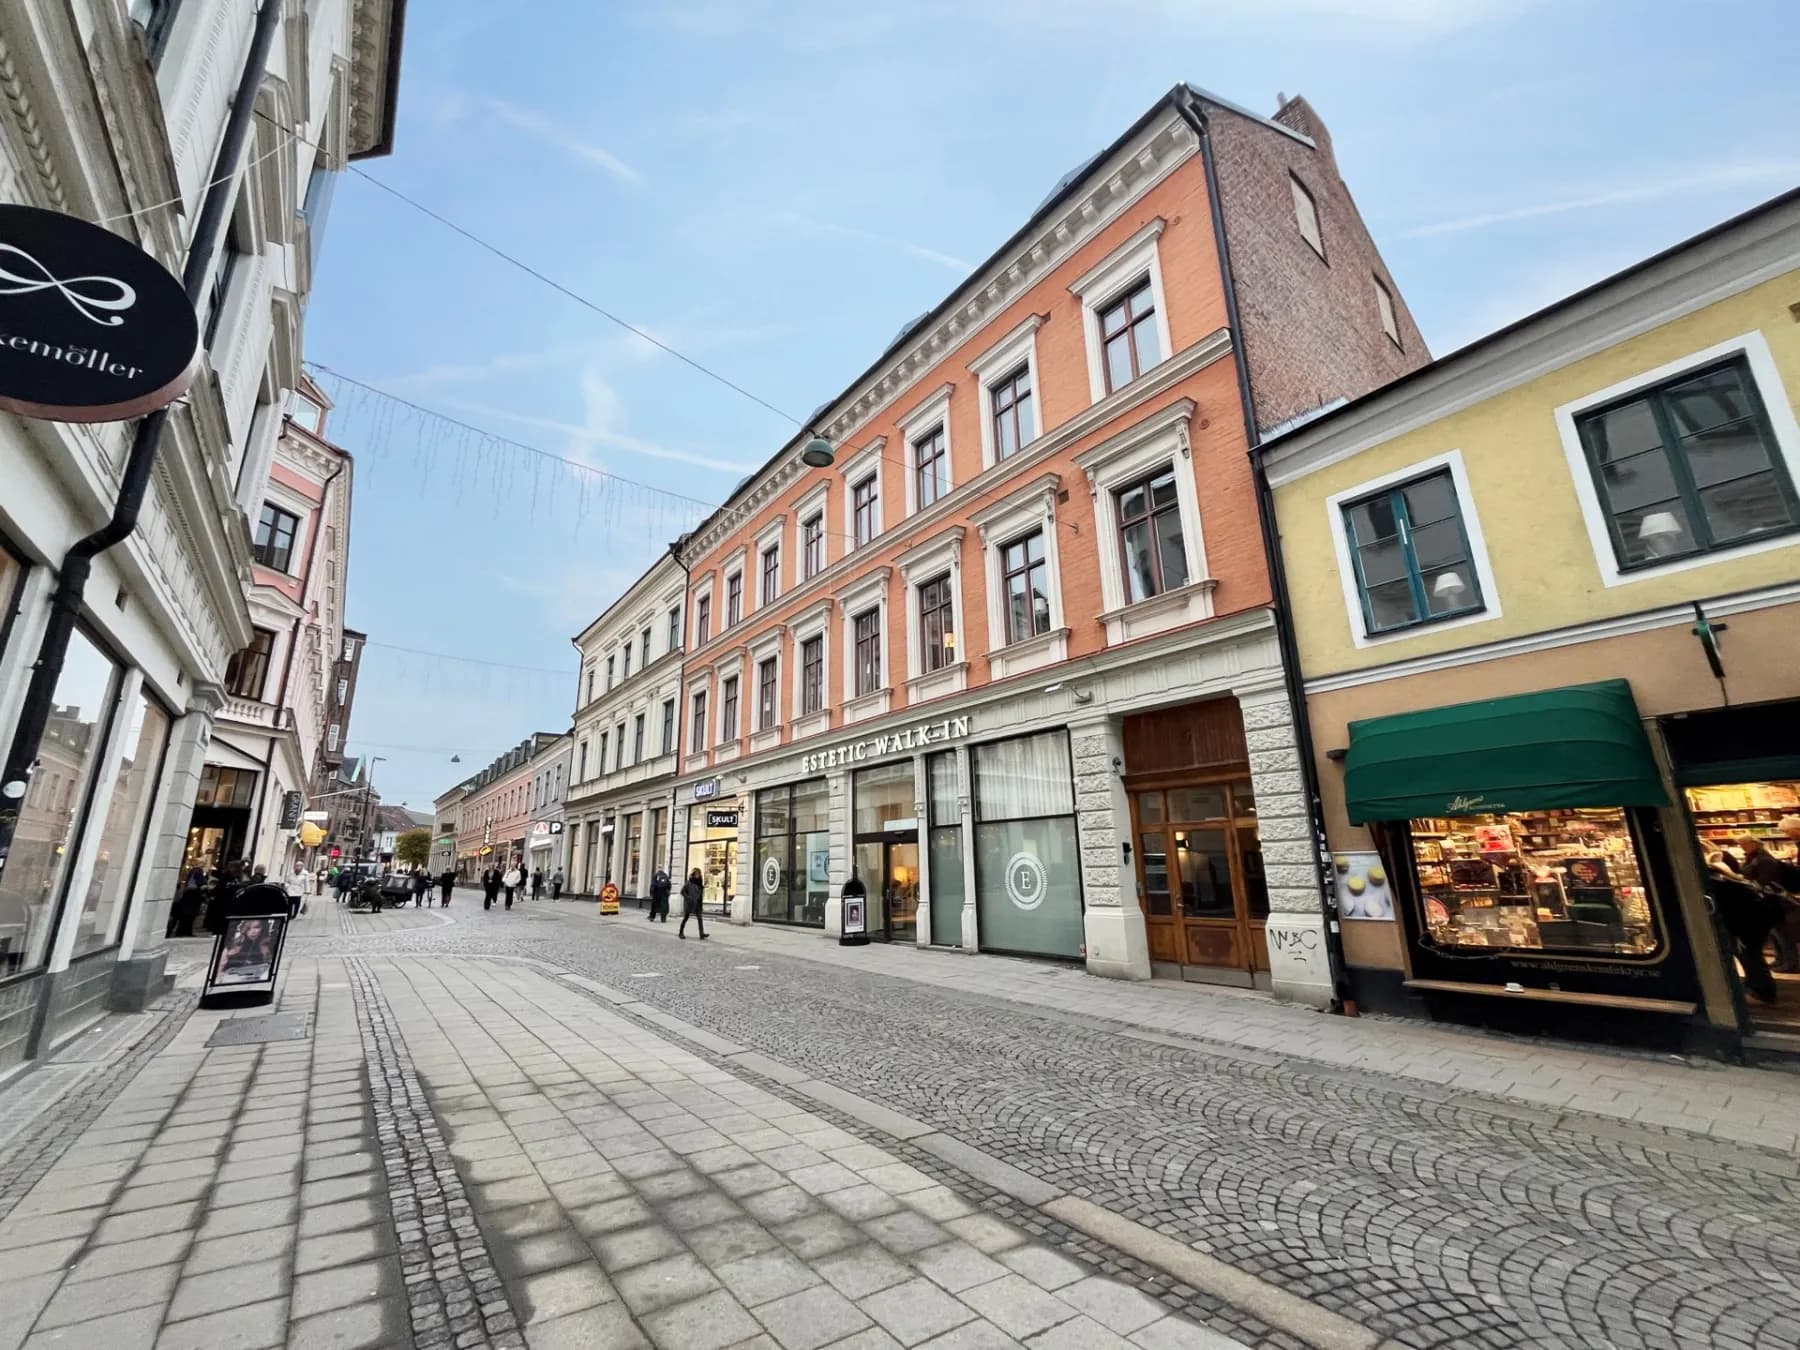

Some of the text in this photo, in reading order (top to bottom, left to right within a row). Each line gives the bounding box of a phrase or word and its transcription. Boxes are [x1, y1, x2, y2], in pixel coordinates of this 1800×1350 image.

[801, 715, 969, 773] ESTETIC WALK-IN
[1021, 871, 1031, 889] E
